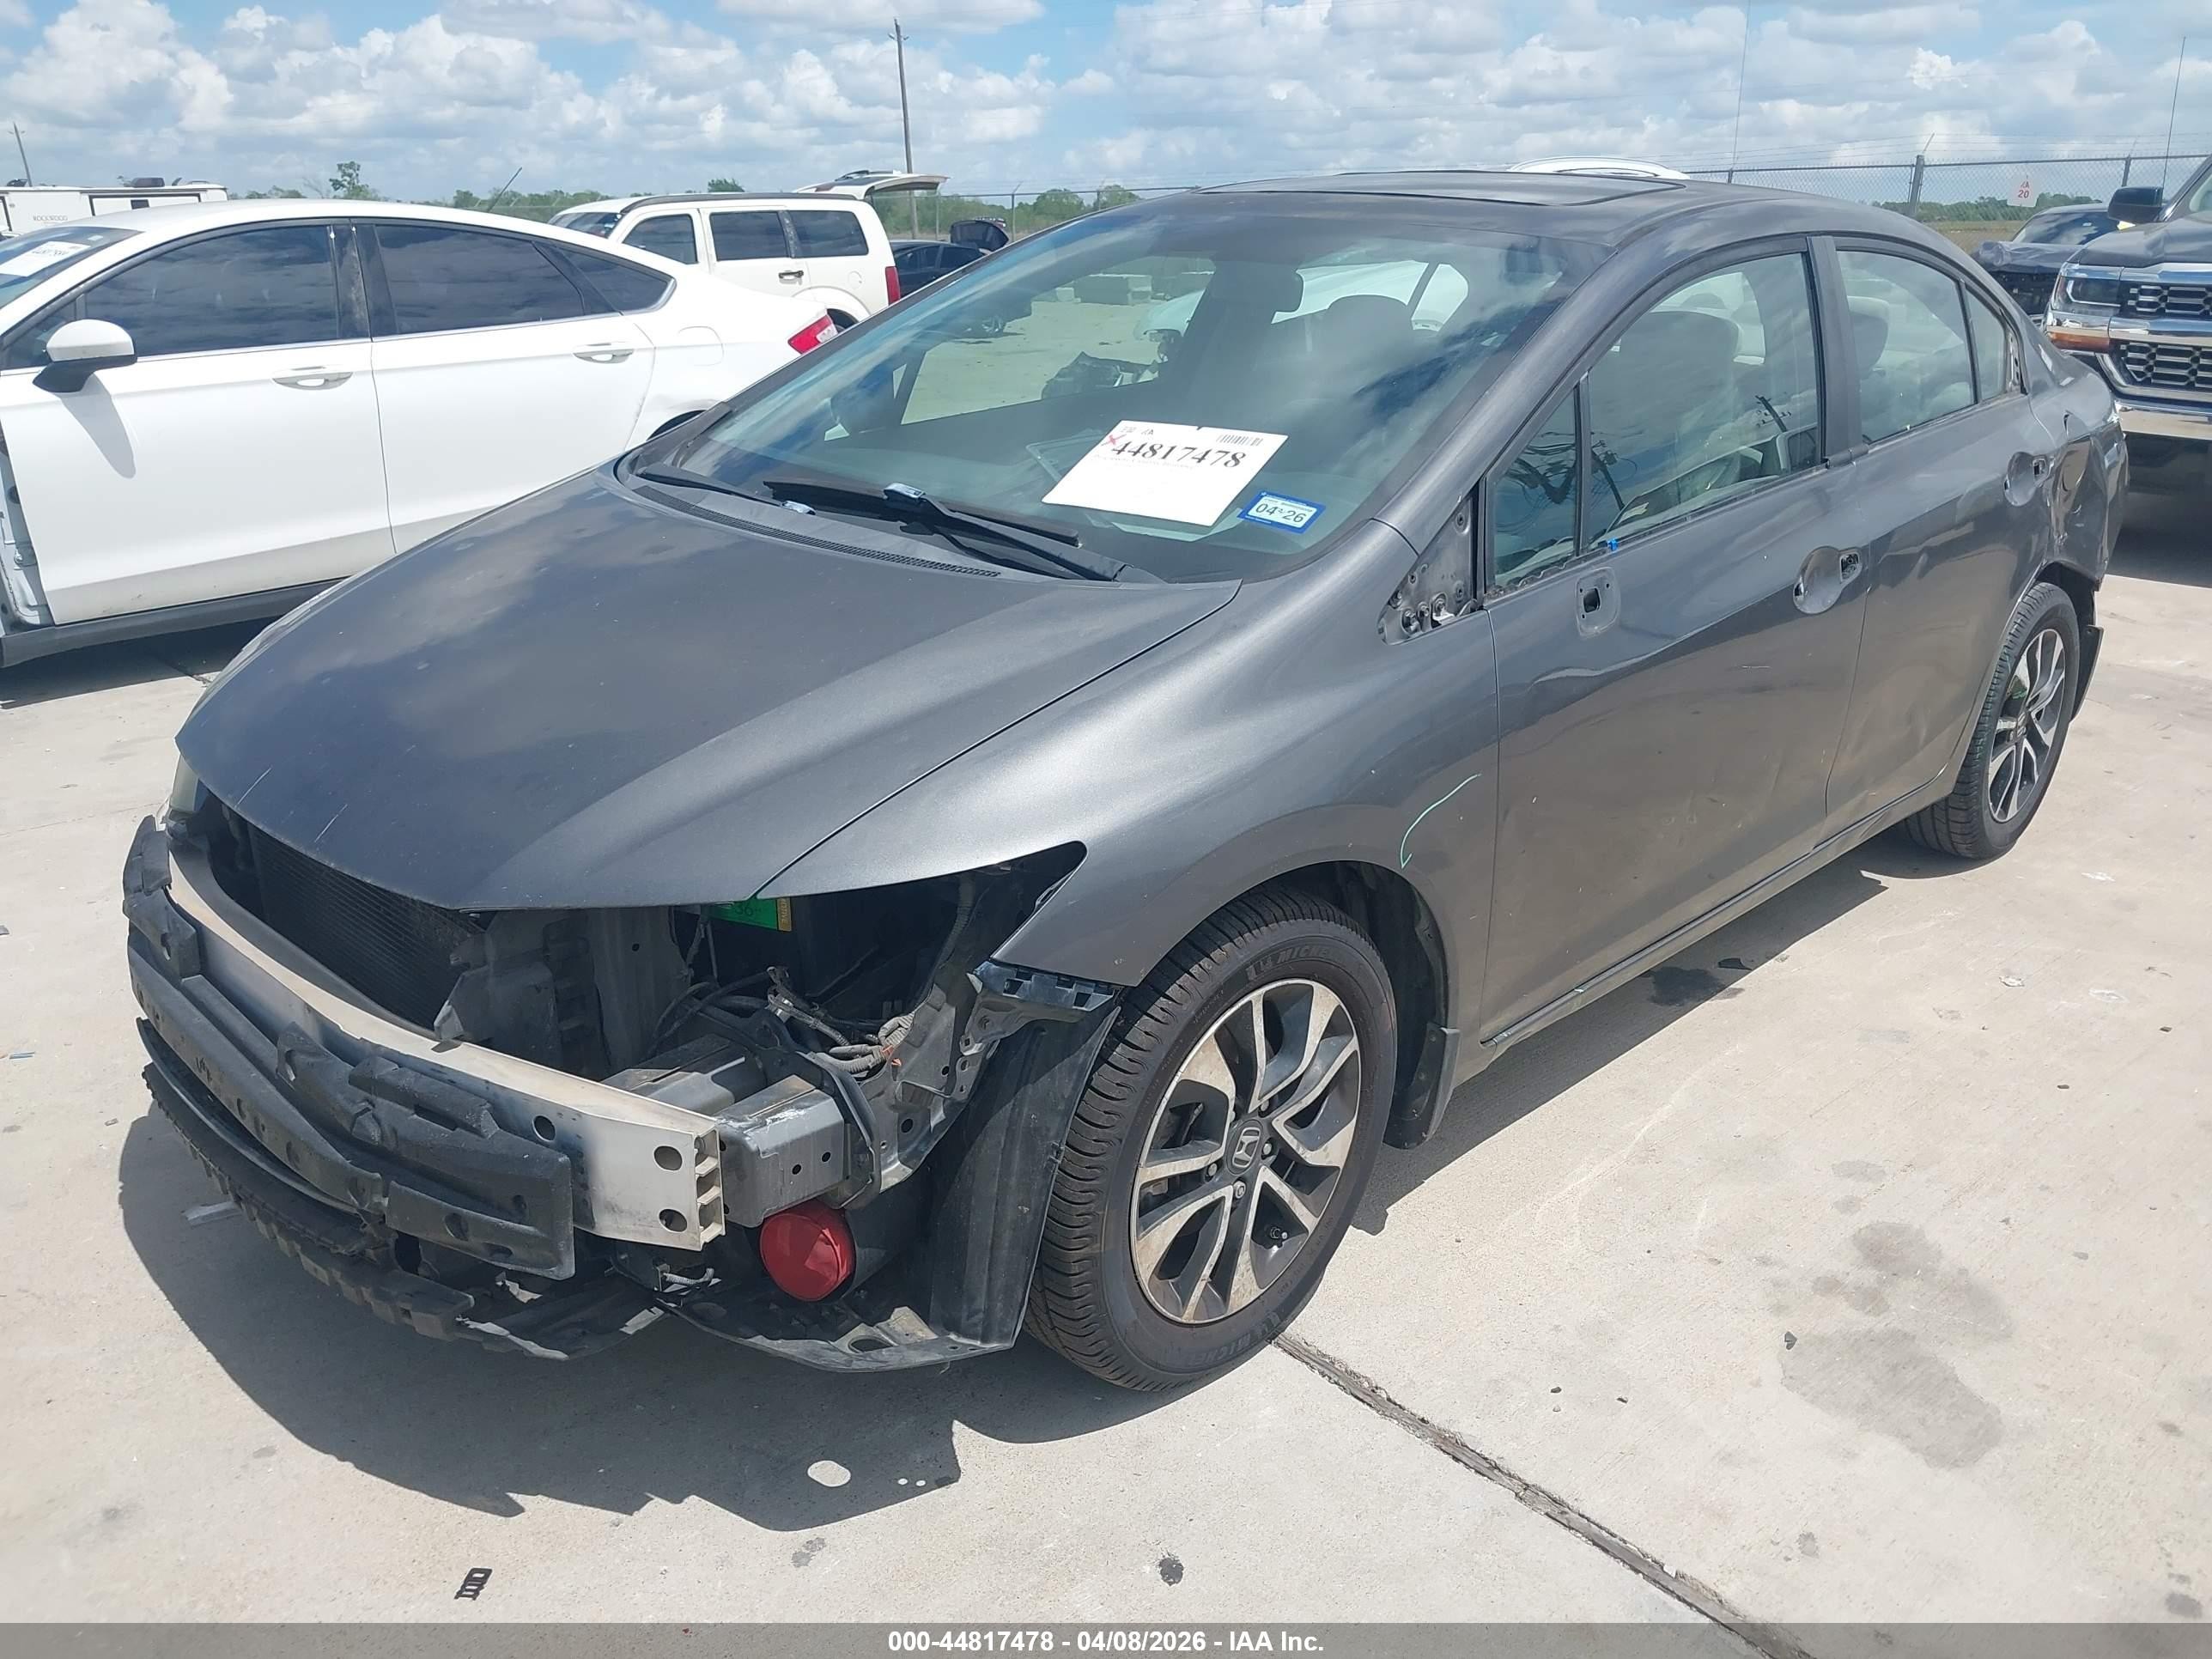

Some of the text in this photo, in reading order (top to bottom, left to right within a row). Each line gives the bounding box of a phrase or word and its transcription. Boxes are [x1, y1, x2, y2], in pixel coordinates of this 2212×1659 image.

[2018, 189, 2030, 198] 20
[1110, 441, 1247, 468] 44817478
[1255, 503, 1279, 516] 04
[1282, 510, 1307, 523] 26
